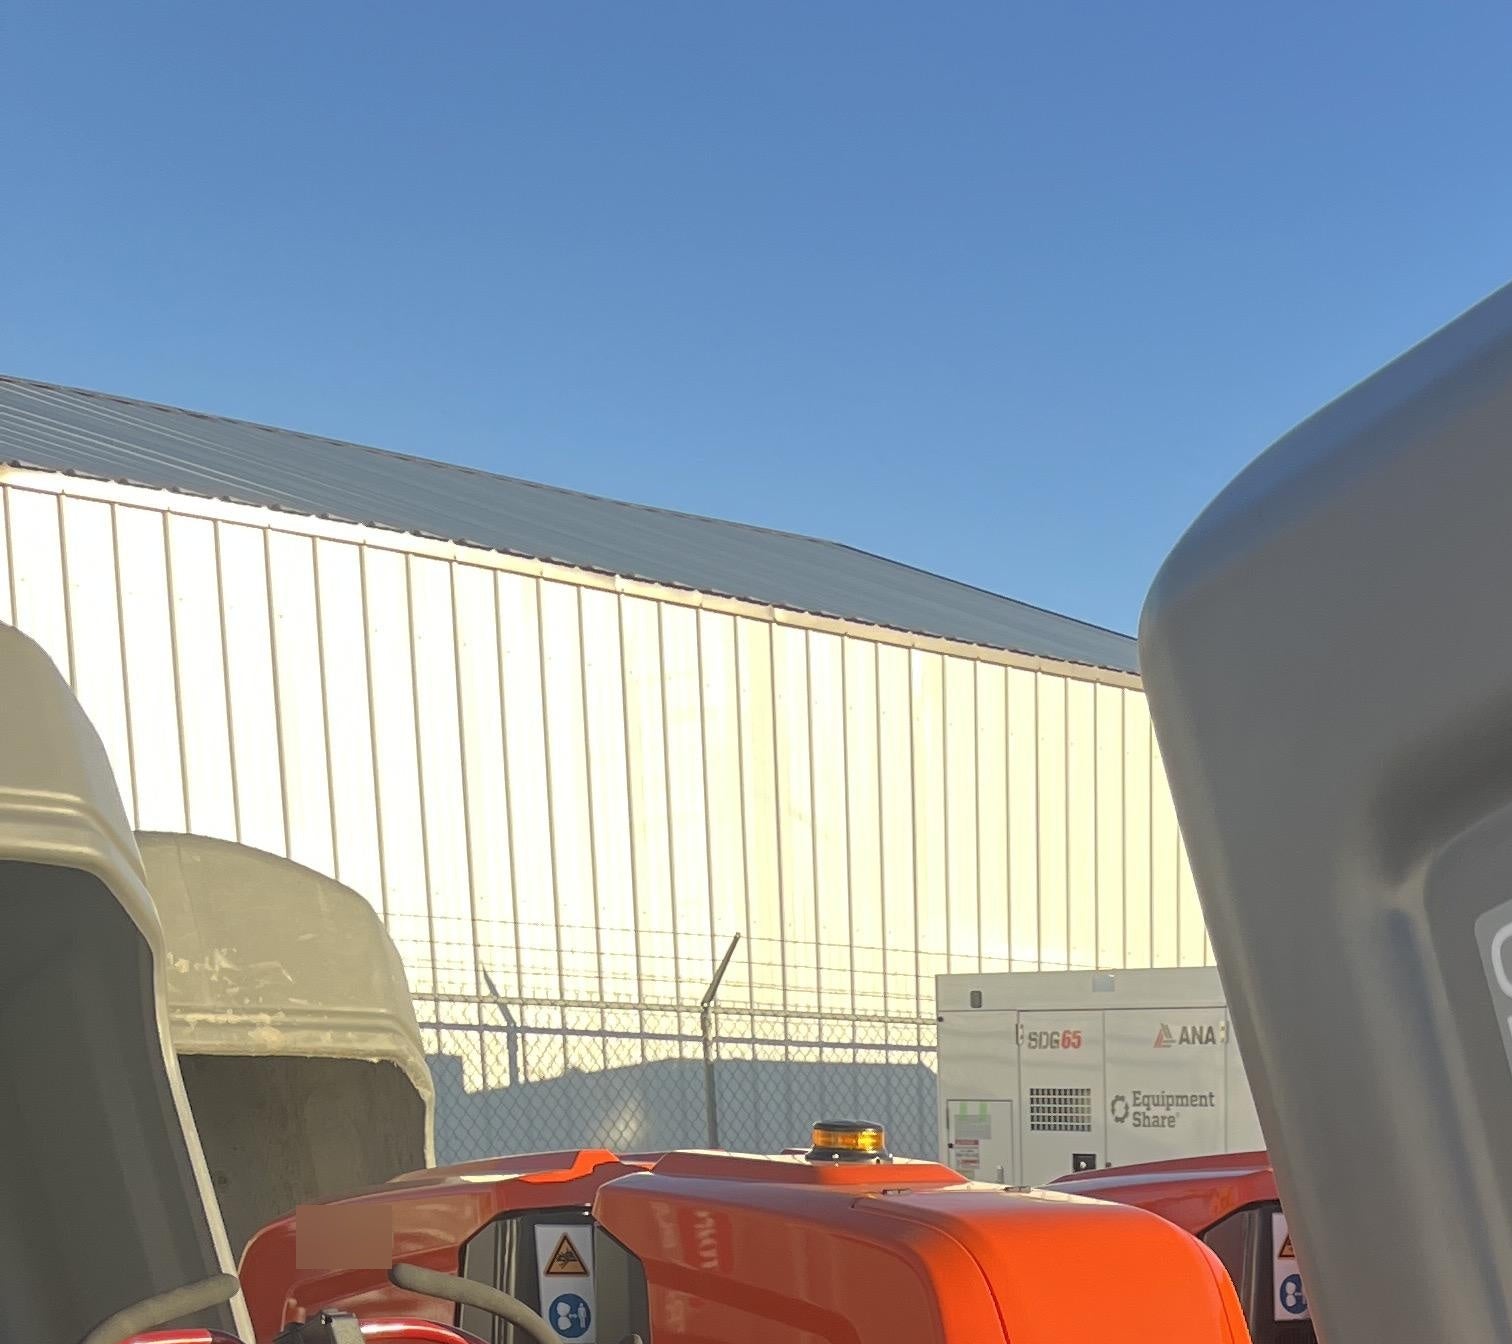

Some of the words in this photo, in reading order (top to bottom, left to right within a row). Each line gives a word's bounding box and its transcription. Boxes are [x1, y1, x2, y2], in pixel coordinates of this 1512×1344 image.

[1178, 1025, 1216, 1045] ANA
[1132, 1090, 1215, 1110] Equipment
[1132, 1112, 1176, 1128] Share
